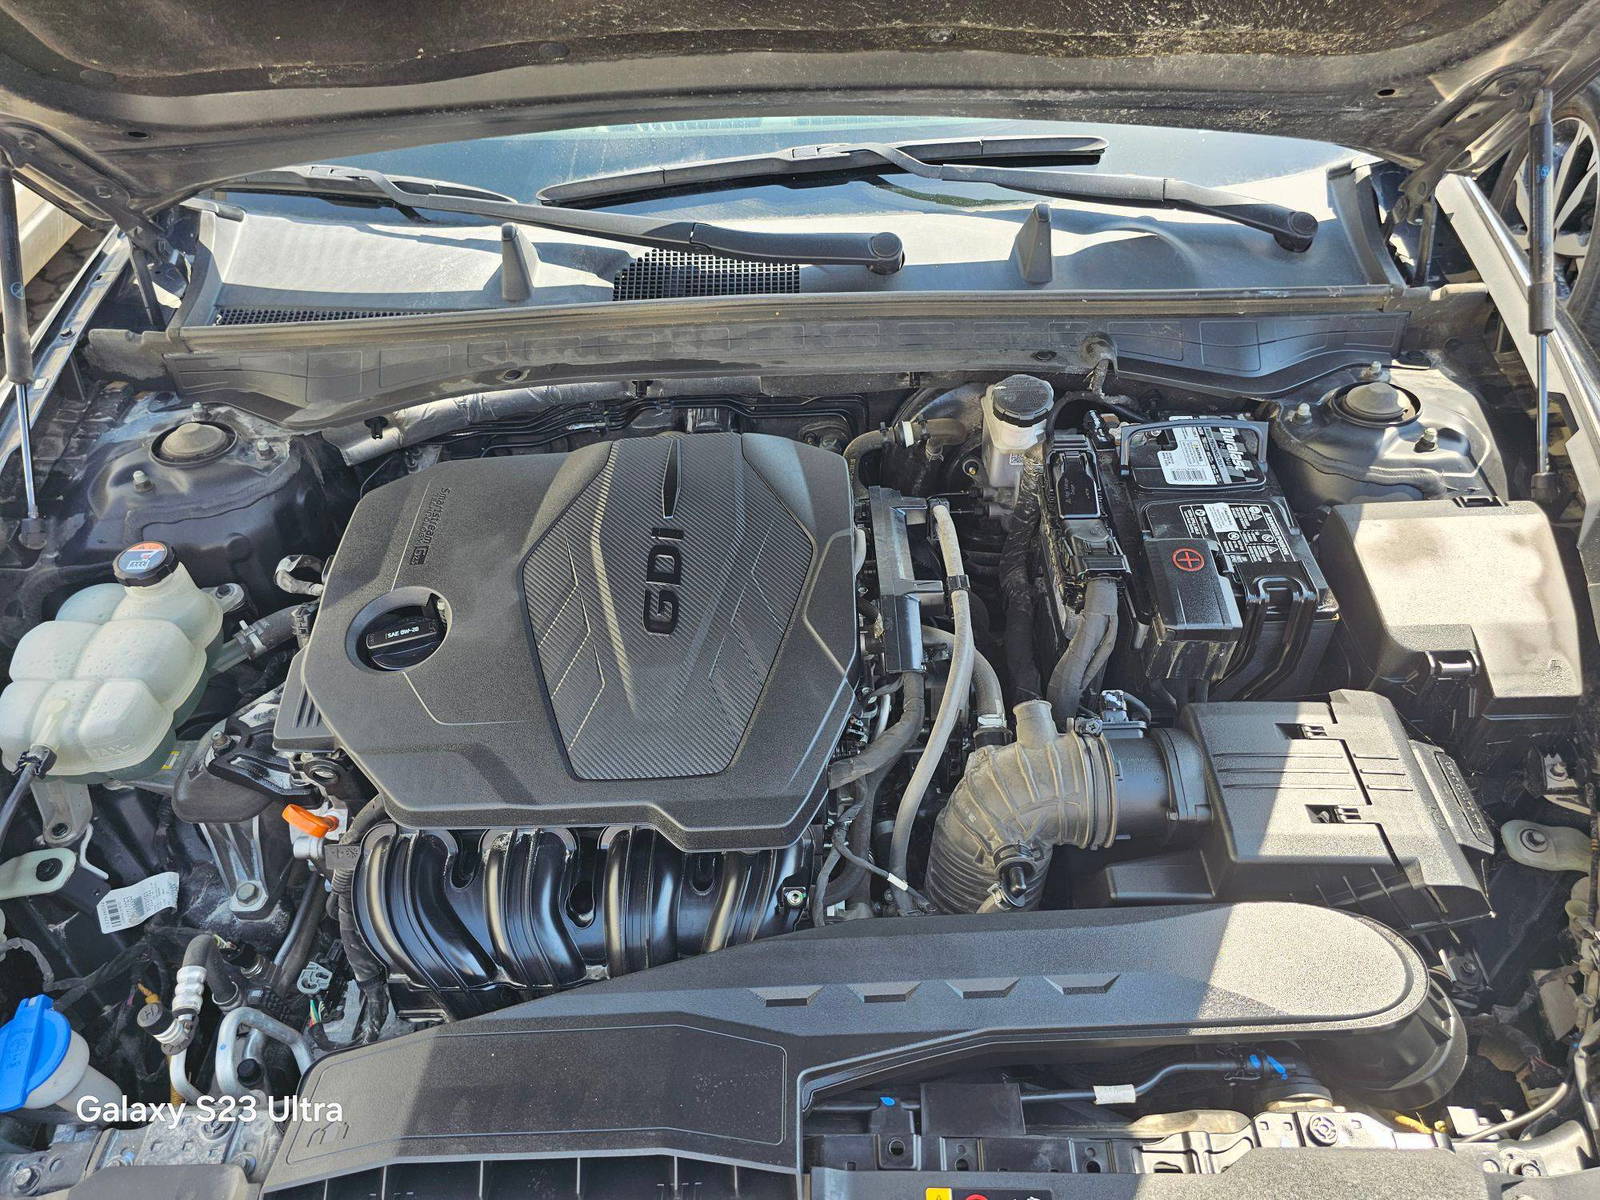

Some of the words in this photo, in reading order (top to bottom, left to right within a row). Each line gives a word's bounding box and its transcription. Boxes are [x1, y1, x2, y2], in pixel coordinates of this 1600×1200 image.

[1219, 427, 1251, 472] Duralast
[424, 487, 451, 544] Smartstream
[642, 527, 685, 636] GDI
[387, 630, 400, 639] SAE
